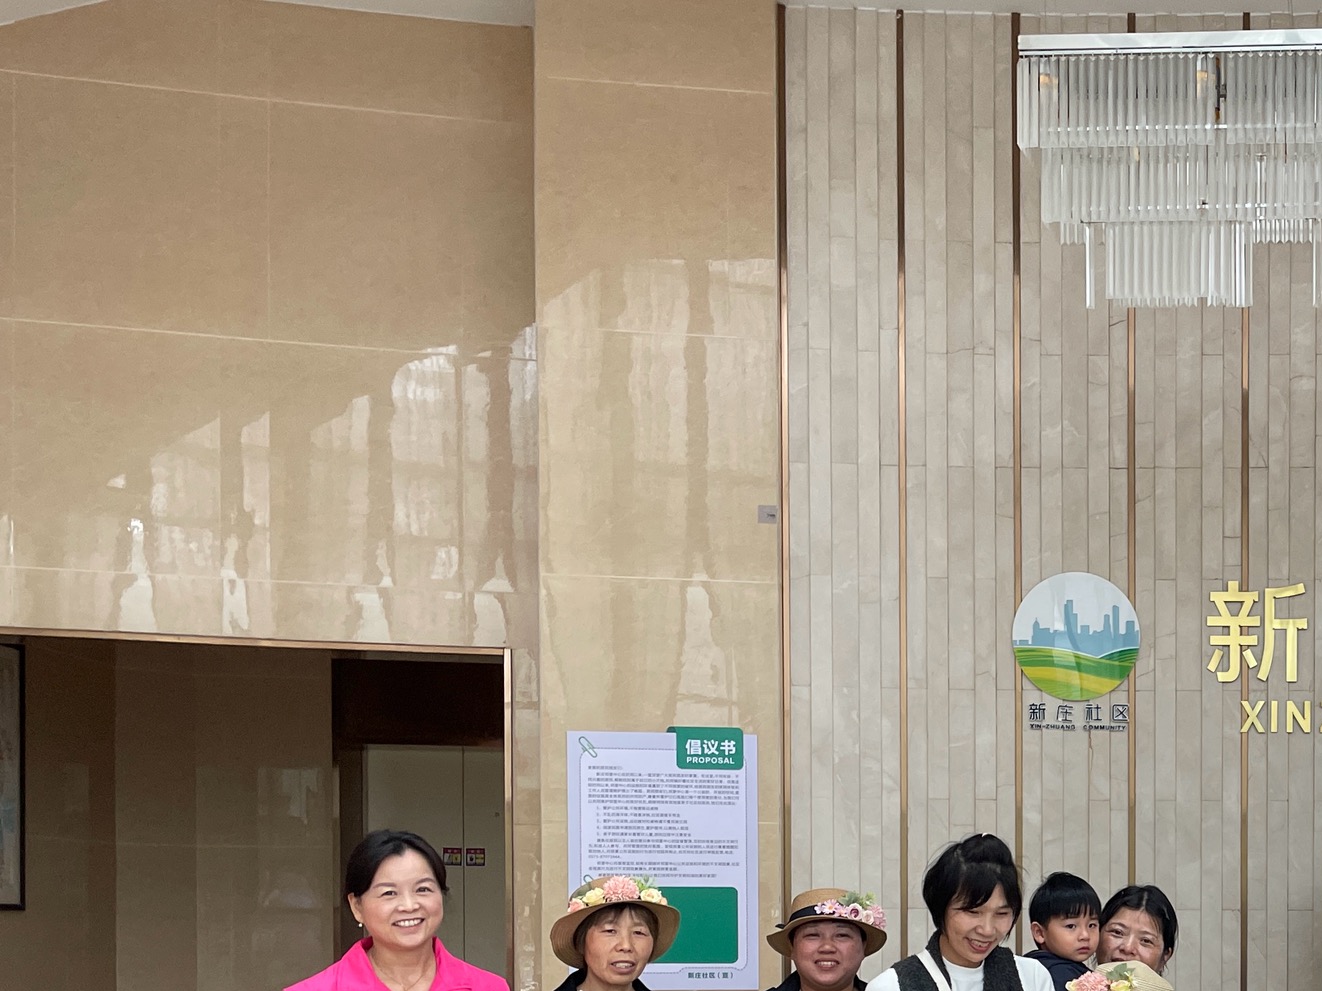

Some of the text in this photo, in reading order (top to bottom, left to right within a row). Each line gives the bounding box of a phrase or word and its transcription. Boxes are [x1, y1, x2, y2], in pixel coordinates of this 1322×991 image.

[1028, 703, 1130, 722] 新庄社区
[1029, 723, 1076, 731] XIN-ZHUANG
[685, 738, 736, 755] 倡议书
[686, 756, 735, 765] PROPOSAL
